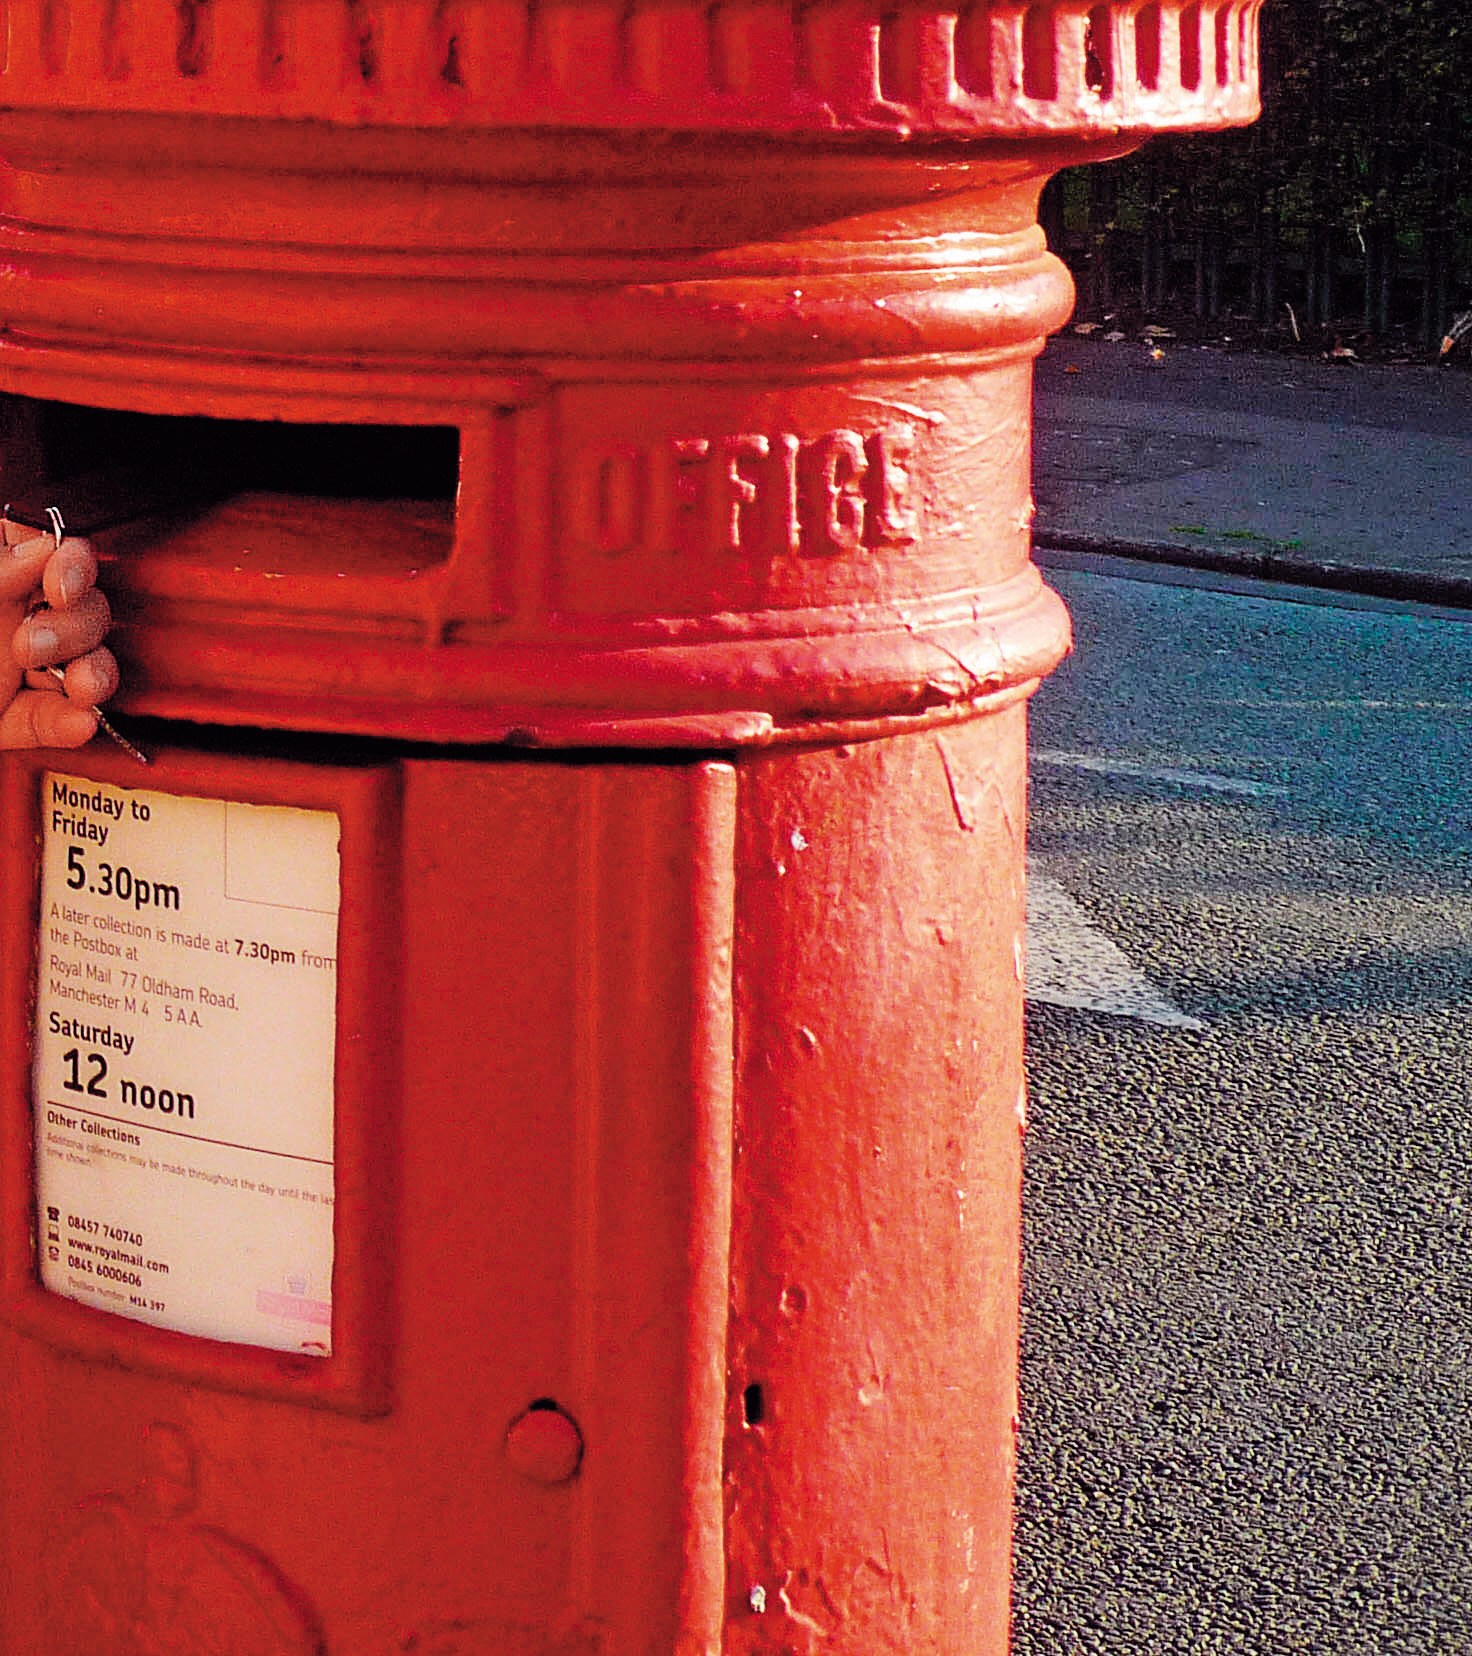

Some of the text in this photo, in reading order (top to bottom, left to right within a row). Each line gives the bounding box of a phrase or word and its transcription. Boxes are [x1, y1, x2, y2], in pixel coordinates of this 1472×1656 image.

[568, 422, 919, 558] OFFICE
[52, 781, 151, 821] Monday to
[52, 810, 109, 847] Friday
[66, 845, 180, 910] 5.30pm
[50, 902, 60, 919] A
[62, 905, 90, 925] later
[93, 915, 152, 940] collection
[156, 928, 167, 943] is
[171, 932, 210, 952] made
[215, 940, 230, 954] at
[234, 938, 296, 965] 7.30pm
[50, 928, 138, 962] the Postbox at
[49, 978, 120, 1010] Manchester
[124, 995, 137, 1014] M
[141, 999, 150, 1016] 4
[50, 954, 82, 978] Royal
[86, 963, 112, 984] Mail
[120, 970, 137, 989] 77
[142, 975, 195, 1002] Oldham
[49, 1011, 135, 1055] Saturday
[63, 1048, 195, 1119] 12 noon
[47, 1110, 77, 1130] Other
[81, 1119, 141, 1146] Collections
[67, 1215, 143, 1247] 08457 740740
[67, 1238, 170, 1274] www.royalmail.com
[67, 1255, 93, 1273] 0845
